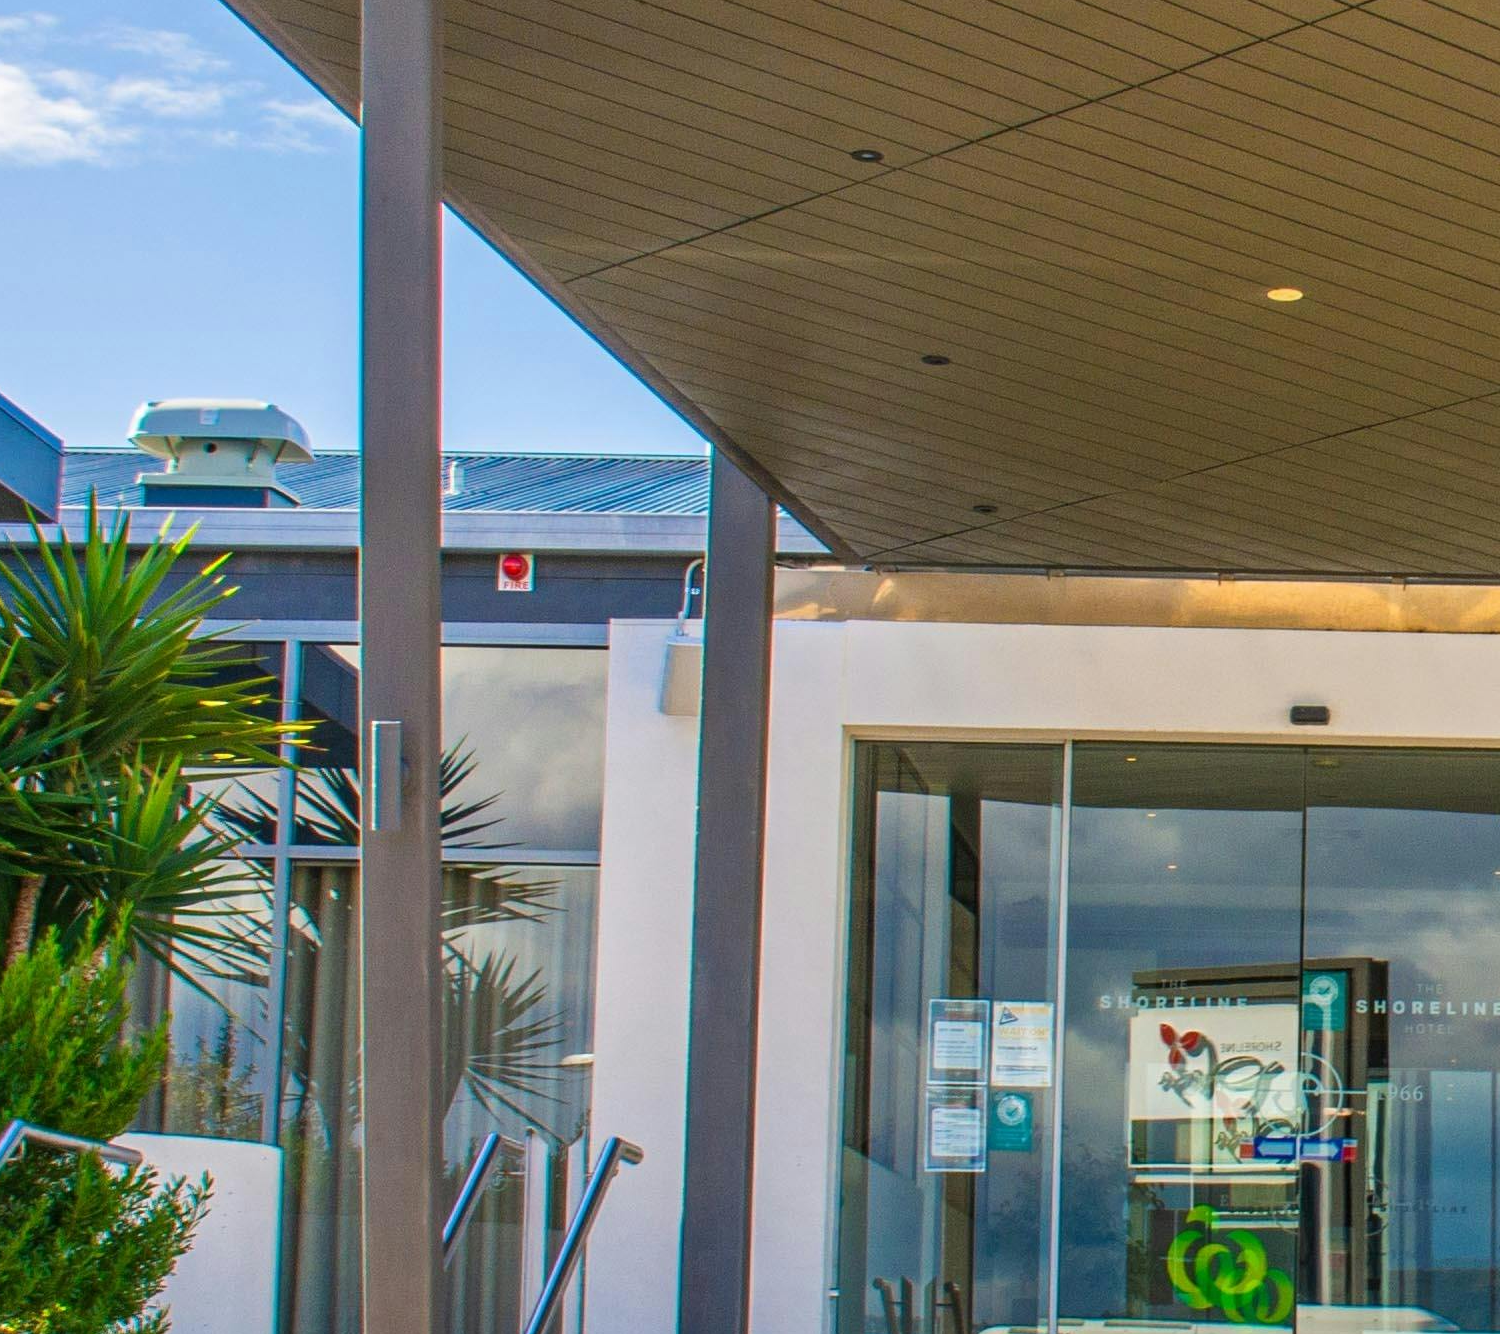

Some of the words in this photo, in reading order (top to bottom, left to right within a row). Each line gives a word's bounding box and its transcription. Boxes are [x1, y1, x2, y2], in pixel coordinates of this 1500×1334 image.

[503, 581, 529, 589] FIRE
[1416, 983, 1445, 994] THE
[1099, 995, 1248, 1009] SHORELINE
[1404, 1023, 1454, 1035] HOTEL
